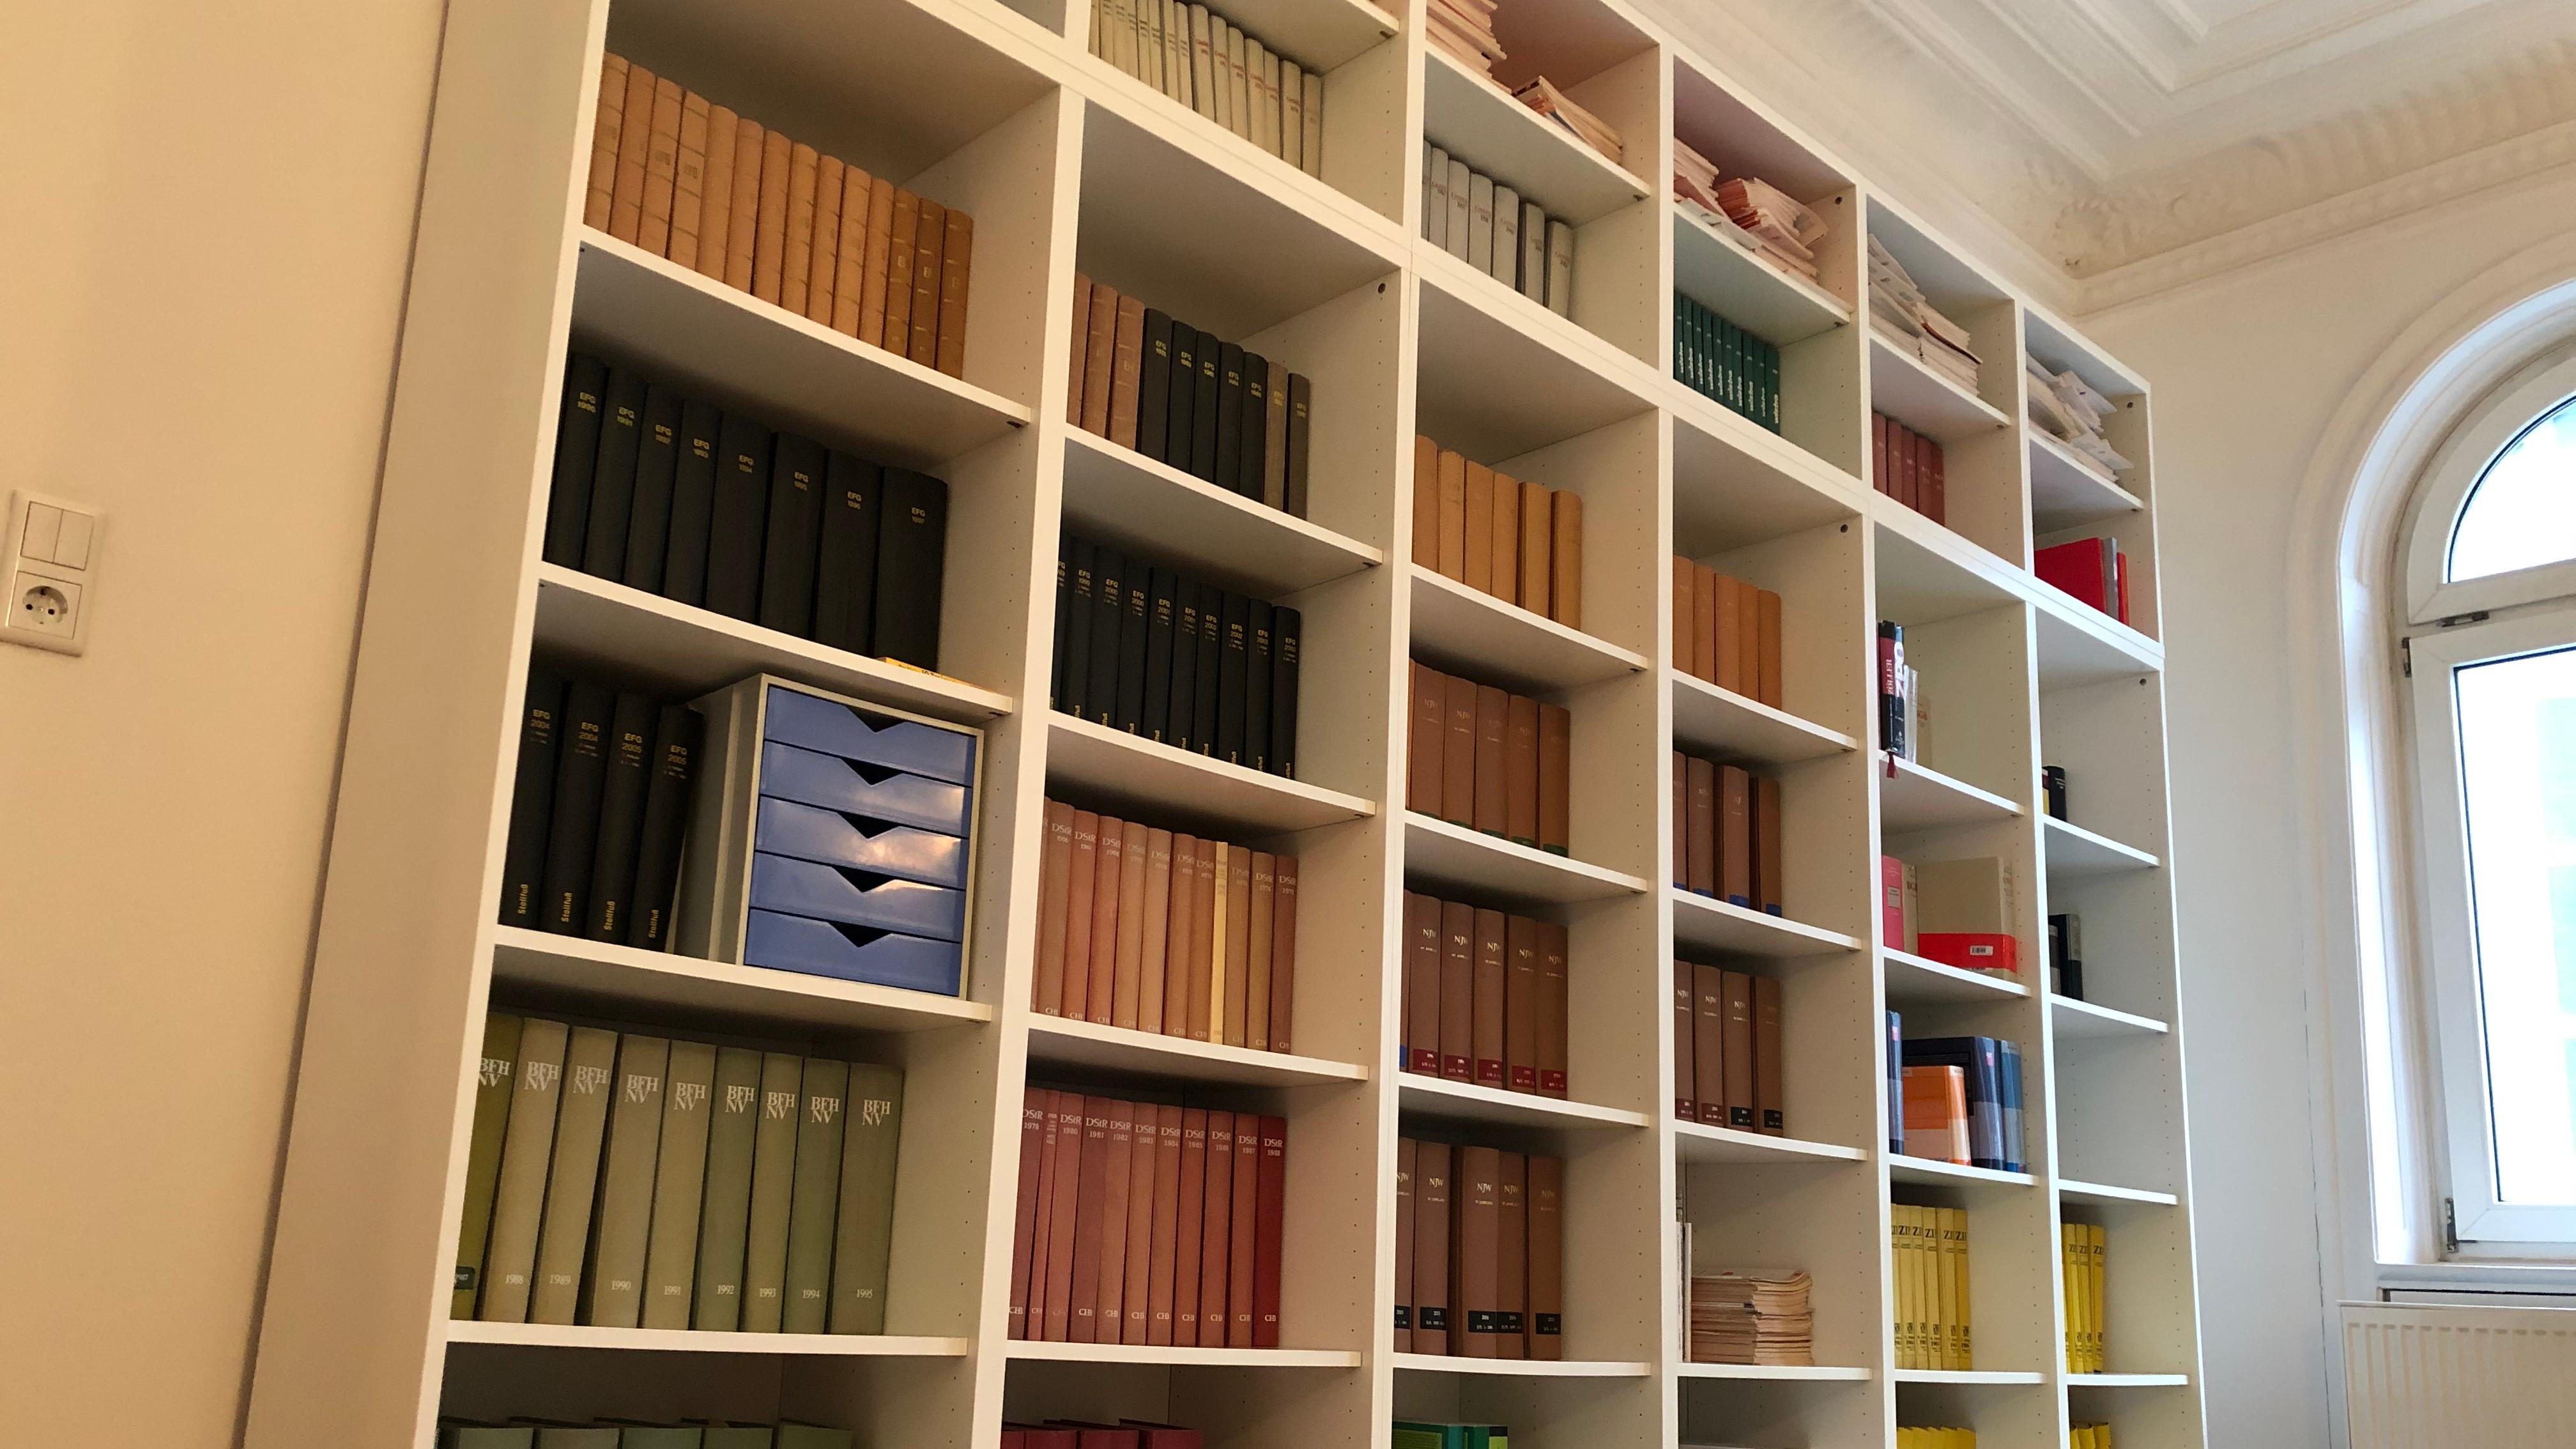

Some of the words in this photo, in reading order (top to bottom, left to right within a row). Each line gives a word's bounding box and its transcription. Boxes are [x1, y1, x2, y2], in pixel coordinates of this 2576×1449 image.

[579, 392, 596, 404] EFG
[618, 406, 634, 418] EFG
[656, 424, 671, 436] EFG
[693, 438, 710, 450] EFG
[739, 454, 754, 466] EFG
[794, 471, 809, 483] EFG
[847, 491, 862, 502] EFG
[911, 507, 926, 517] EFG
[1078, 570, 1091, 579] EFG
[1106, 579, 1118, 588] EFG
[1133, 590, 1144, 599] EFG
[1158, 599, 1170, 608] EFG
[1185, 608, 1196, 616] EFG
[1206, 615, 1217, 624] EFG
[1232, 624, 1243, 632] EFG
[1257, 629, 1268, 638] EFG
[533, 709, 550, 721] EFG
[581, 722, 599, 733] EFG
[624, 733, 643, 744] EFG
[671, 745, 687, 756] EFG
[1052, 823, 1072, 836] DStR
[1075, 831, 1096, 843] DStR
[1423, 928, 1437, 939] NJW
[1454, 935, 1468, 946] NJW
[479, 1057, 511, 1076] BFH
[527, 1061, 560, 1080] BFH
[479, 1073, 500, 1087] NV
[576, 1066, 609, 1084] BFH
[524, 1076, 551, 1091] NV
[572, 1080, 599, 1094] NV
[627, 1075, 659, 1092] BFH
[625, 1089, 650, 1104] NV
[675, 1082, 706, 1100] BFH
[726, 1085, 755, 1102] BFH
[673, 1096, 698, 1110] NV
[767, 1092, 795, 1108] BFH
[810, 1096, 839, 1112] BFH
[724, 1100, 749, 1114] NV
[765, 1106, 788, 1119] NV
[863, 1100, 891, 1115] BFH
[811, 1110, 834, 1124] NV
[861, 1113, 885, 1126] NV
[1023, 1108, 1043, 1120] DStR
[1060, 1114, 1082, 1124] DStR
[1086, 1117, 1108, 1128] DStR
[1110, 1121, 1131, 1130] DStR
[1135, 1124, 1156, 1134] DStR
[1161, 1127, 1181, 1137] DStR
[1186, 1130, 1205, 1139] DStR
[1212, 1131, 1231, 1141] DStR
[1239, 1135, 1257, 1145] DStR
[1264, 1138, 1283, 1148] DStR
[1429, 1177, 1443, 1188] NJW
[1477, 1183, 1492, 1193] NJW
[1504, 1185, 1519, 1195] NJW
[611, 1280, 631, 1291] 1990
[664, 1285, 681, 1296] 1991
[716, 1284, 735, 1295] 1992
[758, 1287, 777, 1298] 1993
[802, 1289, 820, 1299] 1994
[856, 1289, 873, 1299] 1995
